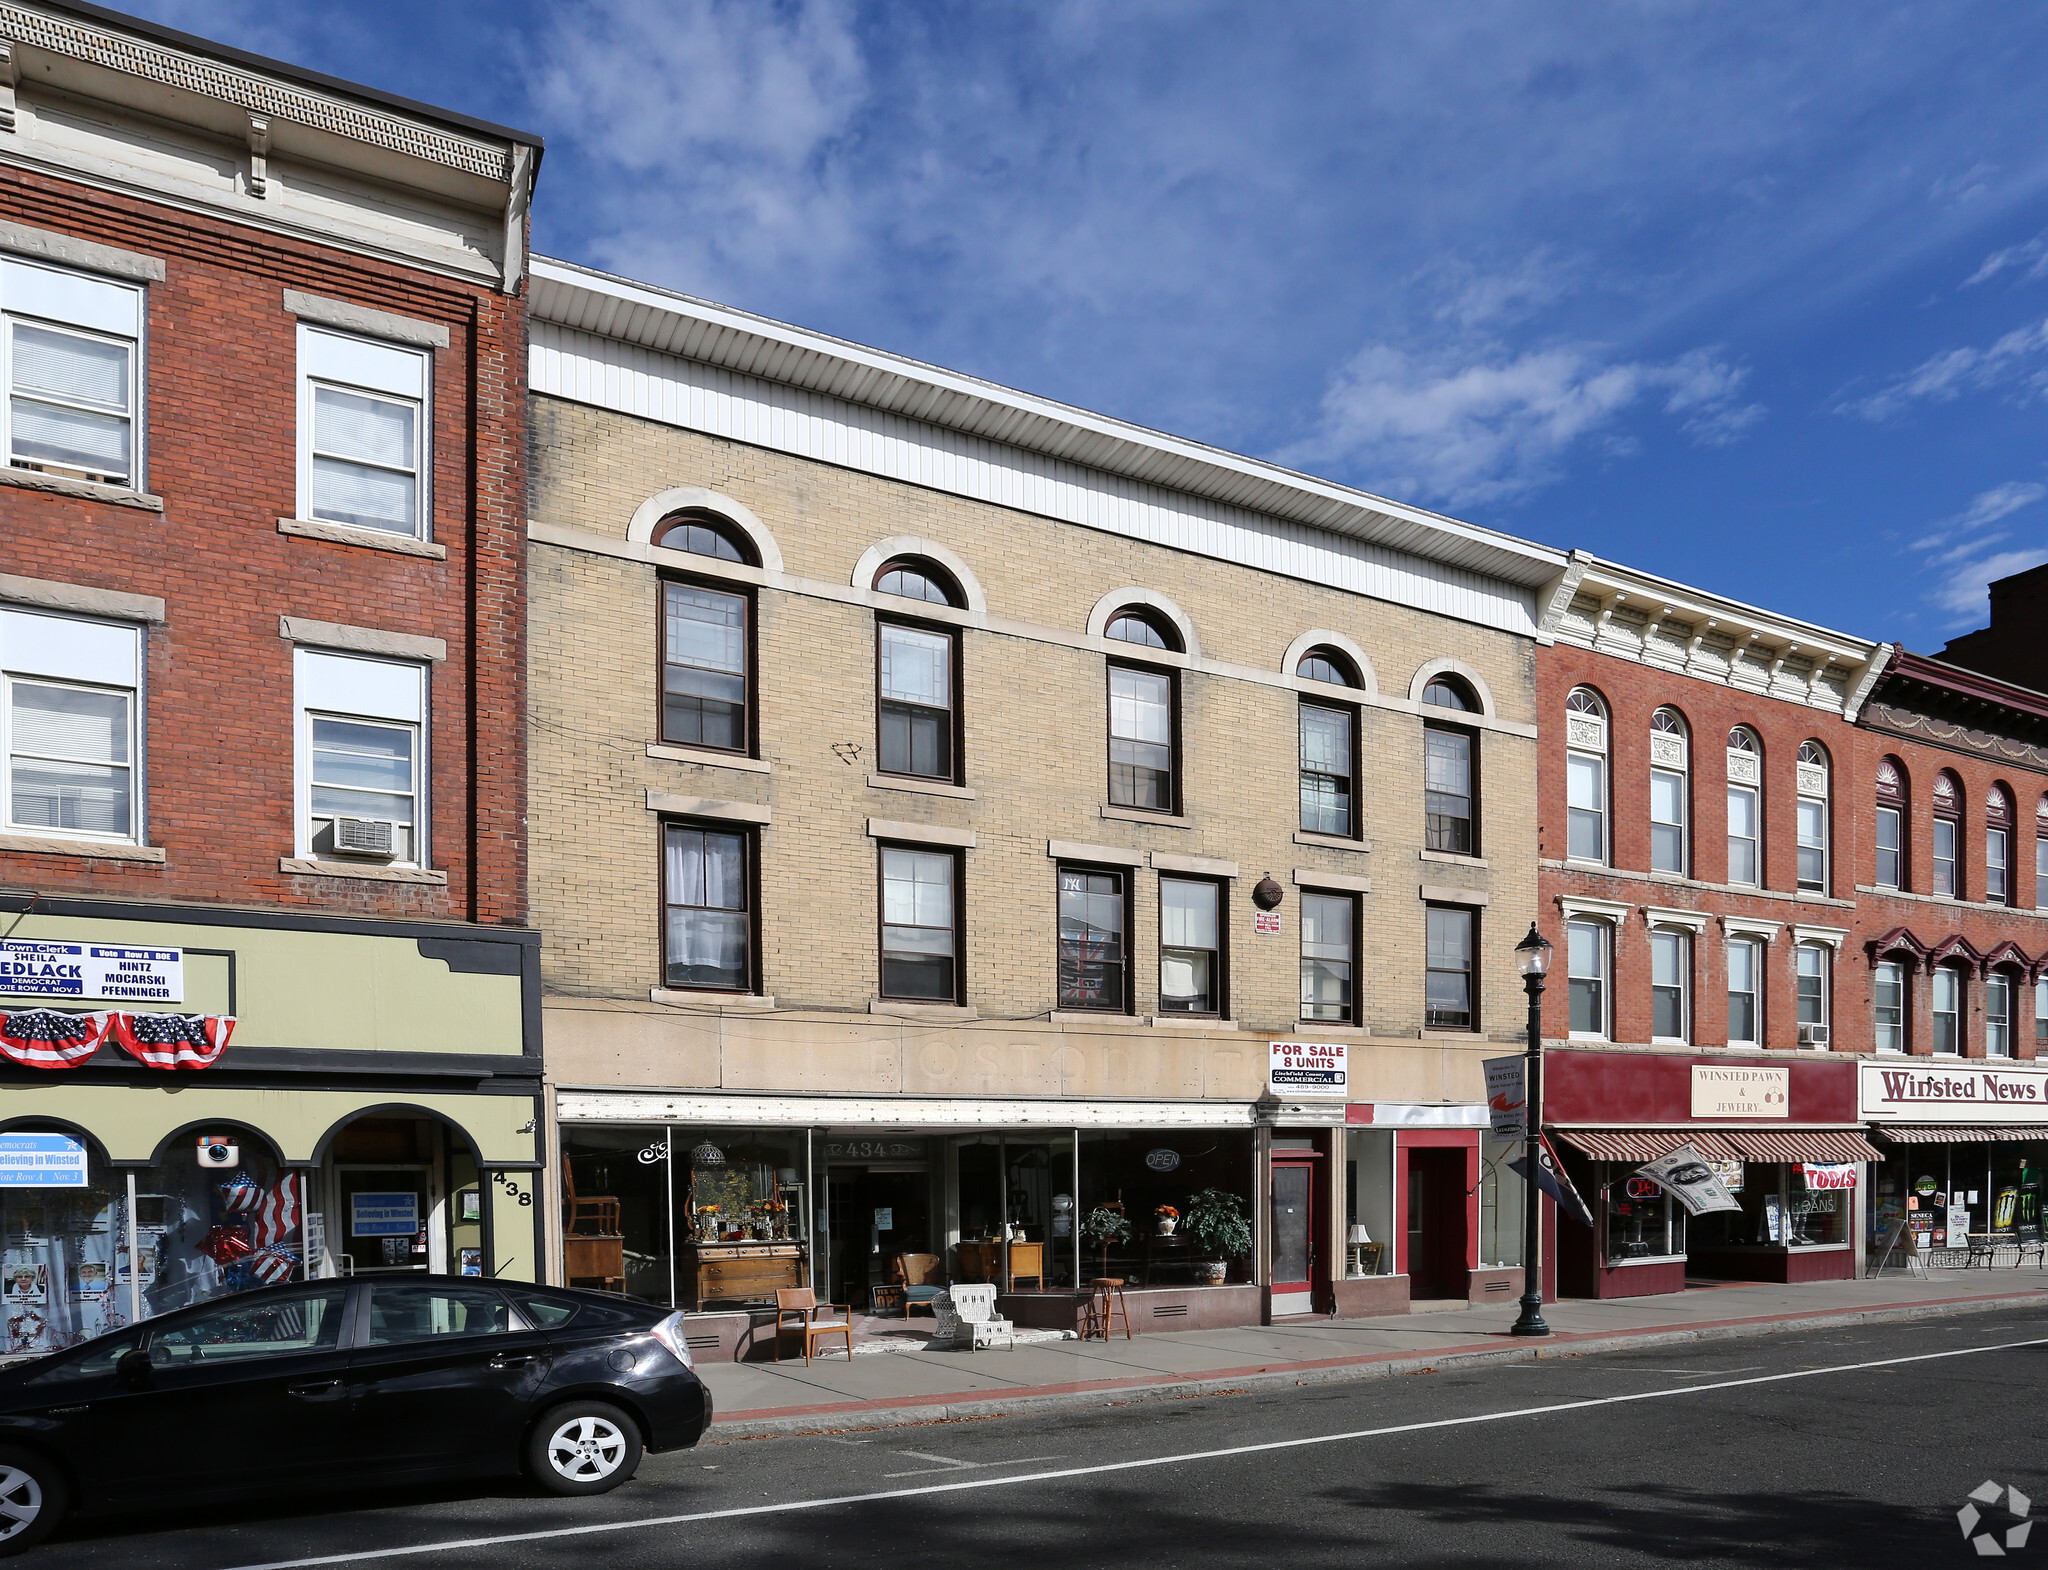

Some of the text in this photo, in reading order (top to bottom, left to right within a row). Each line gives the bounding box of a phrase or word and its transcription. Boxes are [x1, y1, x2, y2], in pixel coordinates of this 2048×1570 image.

[2, 943, 69, 954] Town Clerk
[14, 953, 57, 962] SHEILA
[98, 949, 119, 958] Vote
[124, 951, 143, 959] Row
[155, 952, 172, 961] BOE
[0, 962, 82, 978] EDLACK
[119, 962, 152, 972] HINTZ
[11, 978, 61, 986] DEMOCRAT
[105, 973, 166, 985] MOCARSKI
[101, 985, 170, 998] PFENNINGER
[1273, 1045, 1344, 1057] FOR SALE
[1284, 1057, 1335, 1068] 8 UNITS
[1488, 1071, 1520, 1081] WINSTED
[1699, 1071, 1782, 1081] WINSTED PAWN
[1881, 1071, 1975, 1100] Winsted
[1982, 1074, 2036, 1101] News
[1739, 1087, 1746, 1097] &
[1716, 1103, 1759, 1112] JEWELRY
[846, 1142, 886, 1157] 434
[36, 1154, 44, 1165] in
[45, 1154, 80, 1165] Winsted
[1146, 1153, 1179, 1165] OPEN
[16, 1172, 36, 1181] Row
[36, 1172, 43, 1181] A
[53, 1172, 71, 1181] Nov.
[72, 1171, 79, 1181] 3
[1806, 1169, 1857, 1189] TOOLS
[493, 1169, 532, 1207] 438
[357, 1209, 384, 1219] Believing
[391, 1209, 414, 1218] Winsted
